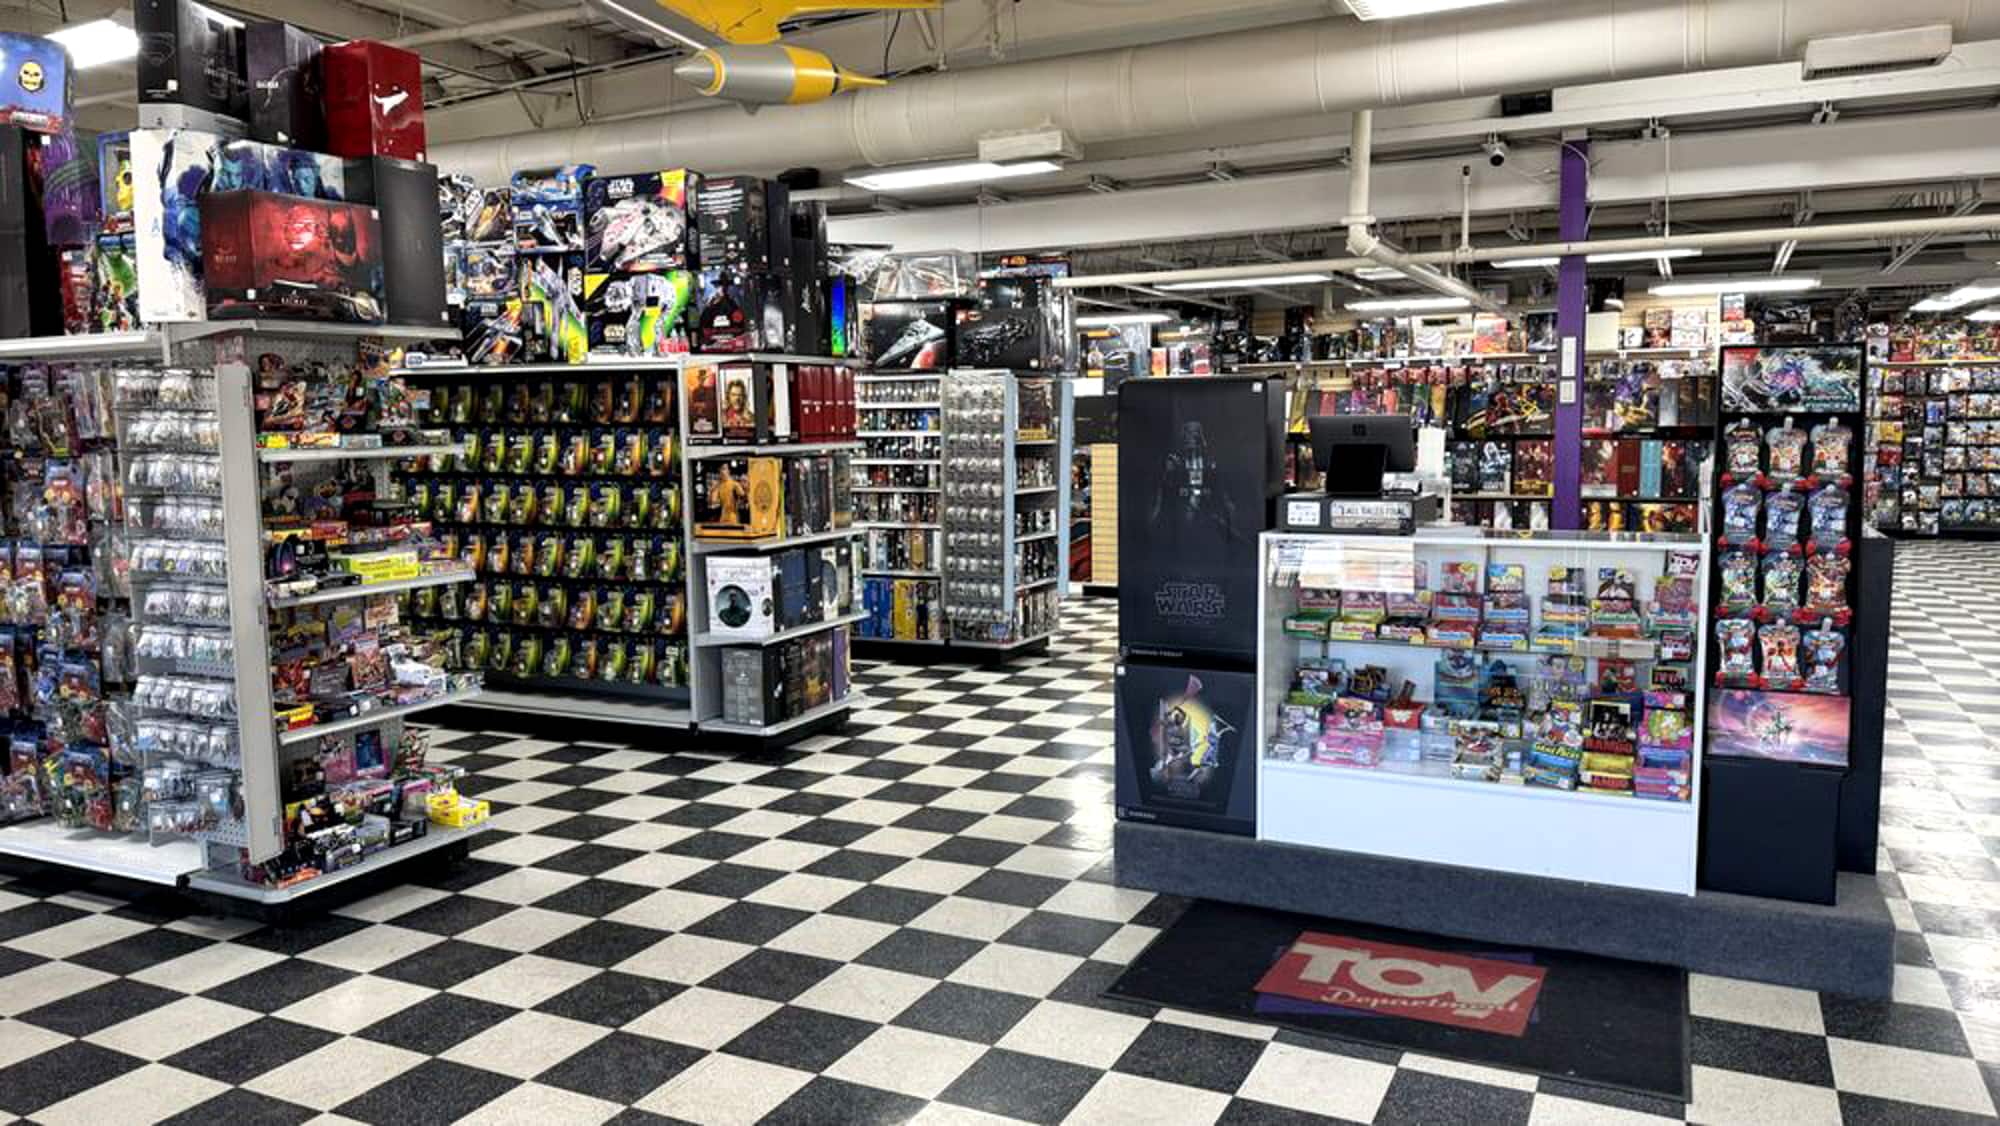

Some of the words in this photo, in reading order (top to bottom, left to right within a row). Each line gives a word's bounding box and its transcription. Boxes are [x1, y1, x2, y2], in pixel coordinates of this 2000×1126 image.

[1155, 583, 1223, 600] STAR
[1157, 600, 1224, 616] WARS
[1291, 943, 1537, 1018] TOY
